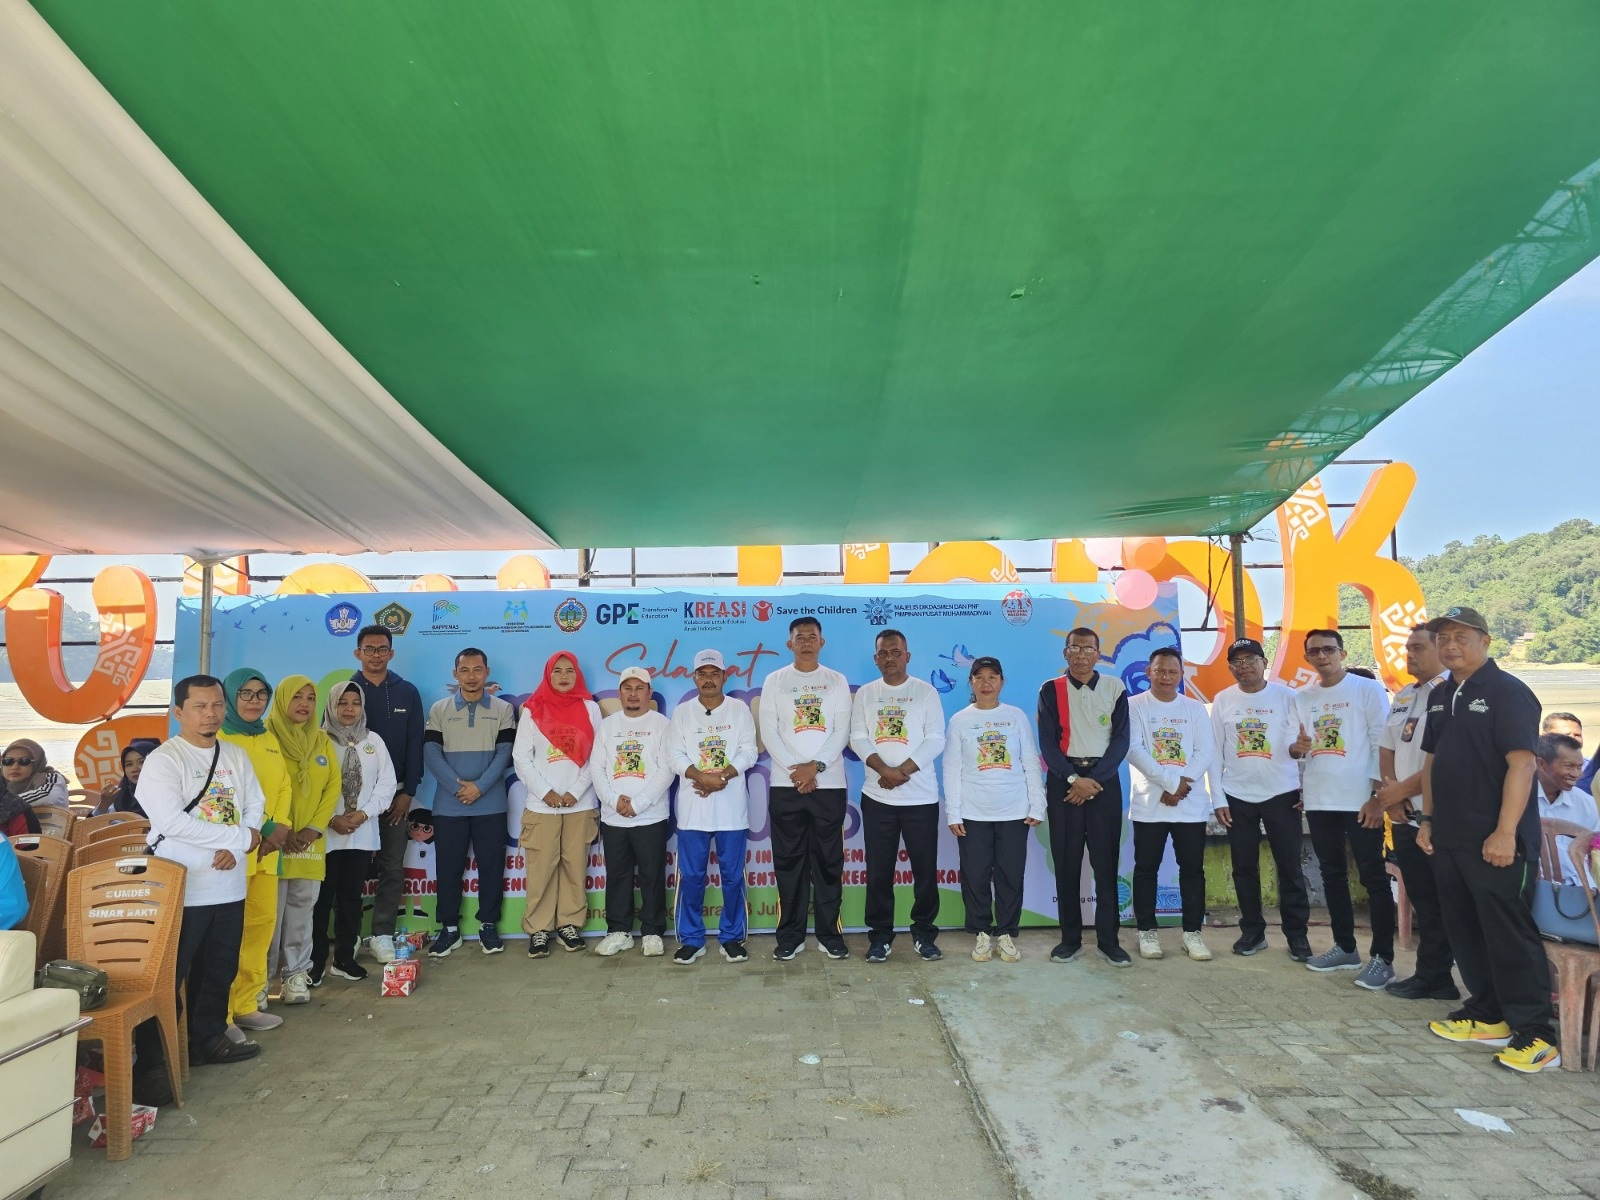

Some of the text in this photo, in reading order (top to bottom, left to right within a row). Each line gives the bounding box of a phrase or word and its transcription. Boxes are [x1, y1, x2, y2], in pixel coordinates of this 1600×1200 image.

[596, 603, 639, 625] GPE
[776, 605, 857, 615] Save the Children
[605, 638, 780, 688] Selaat
[88, 908, 125, 919] SINAR
